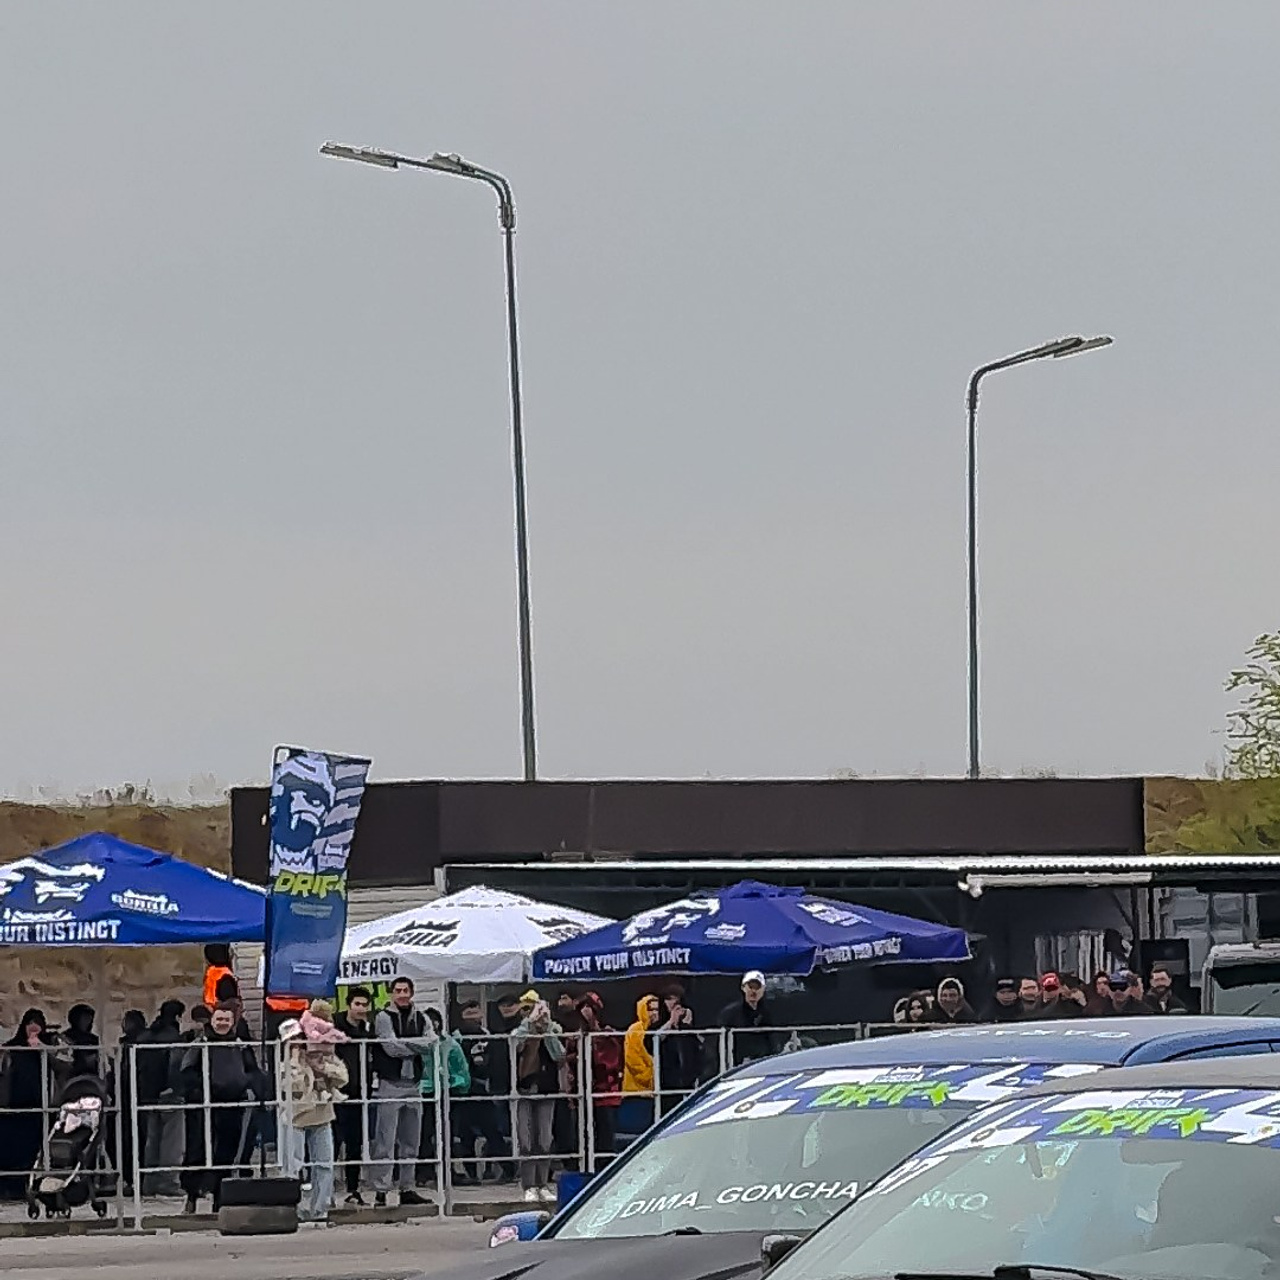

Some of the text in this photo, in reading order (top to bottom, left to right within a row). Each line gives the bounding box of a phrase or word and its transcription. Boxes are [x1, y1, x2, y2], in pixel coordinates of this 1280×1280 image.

[35, 919, 122, 942] INSTINCT
[342, 957, 399, 978] ENERGY
[544, 947, 690, 974] POWER YOUR INSTINCT
